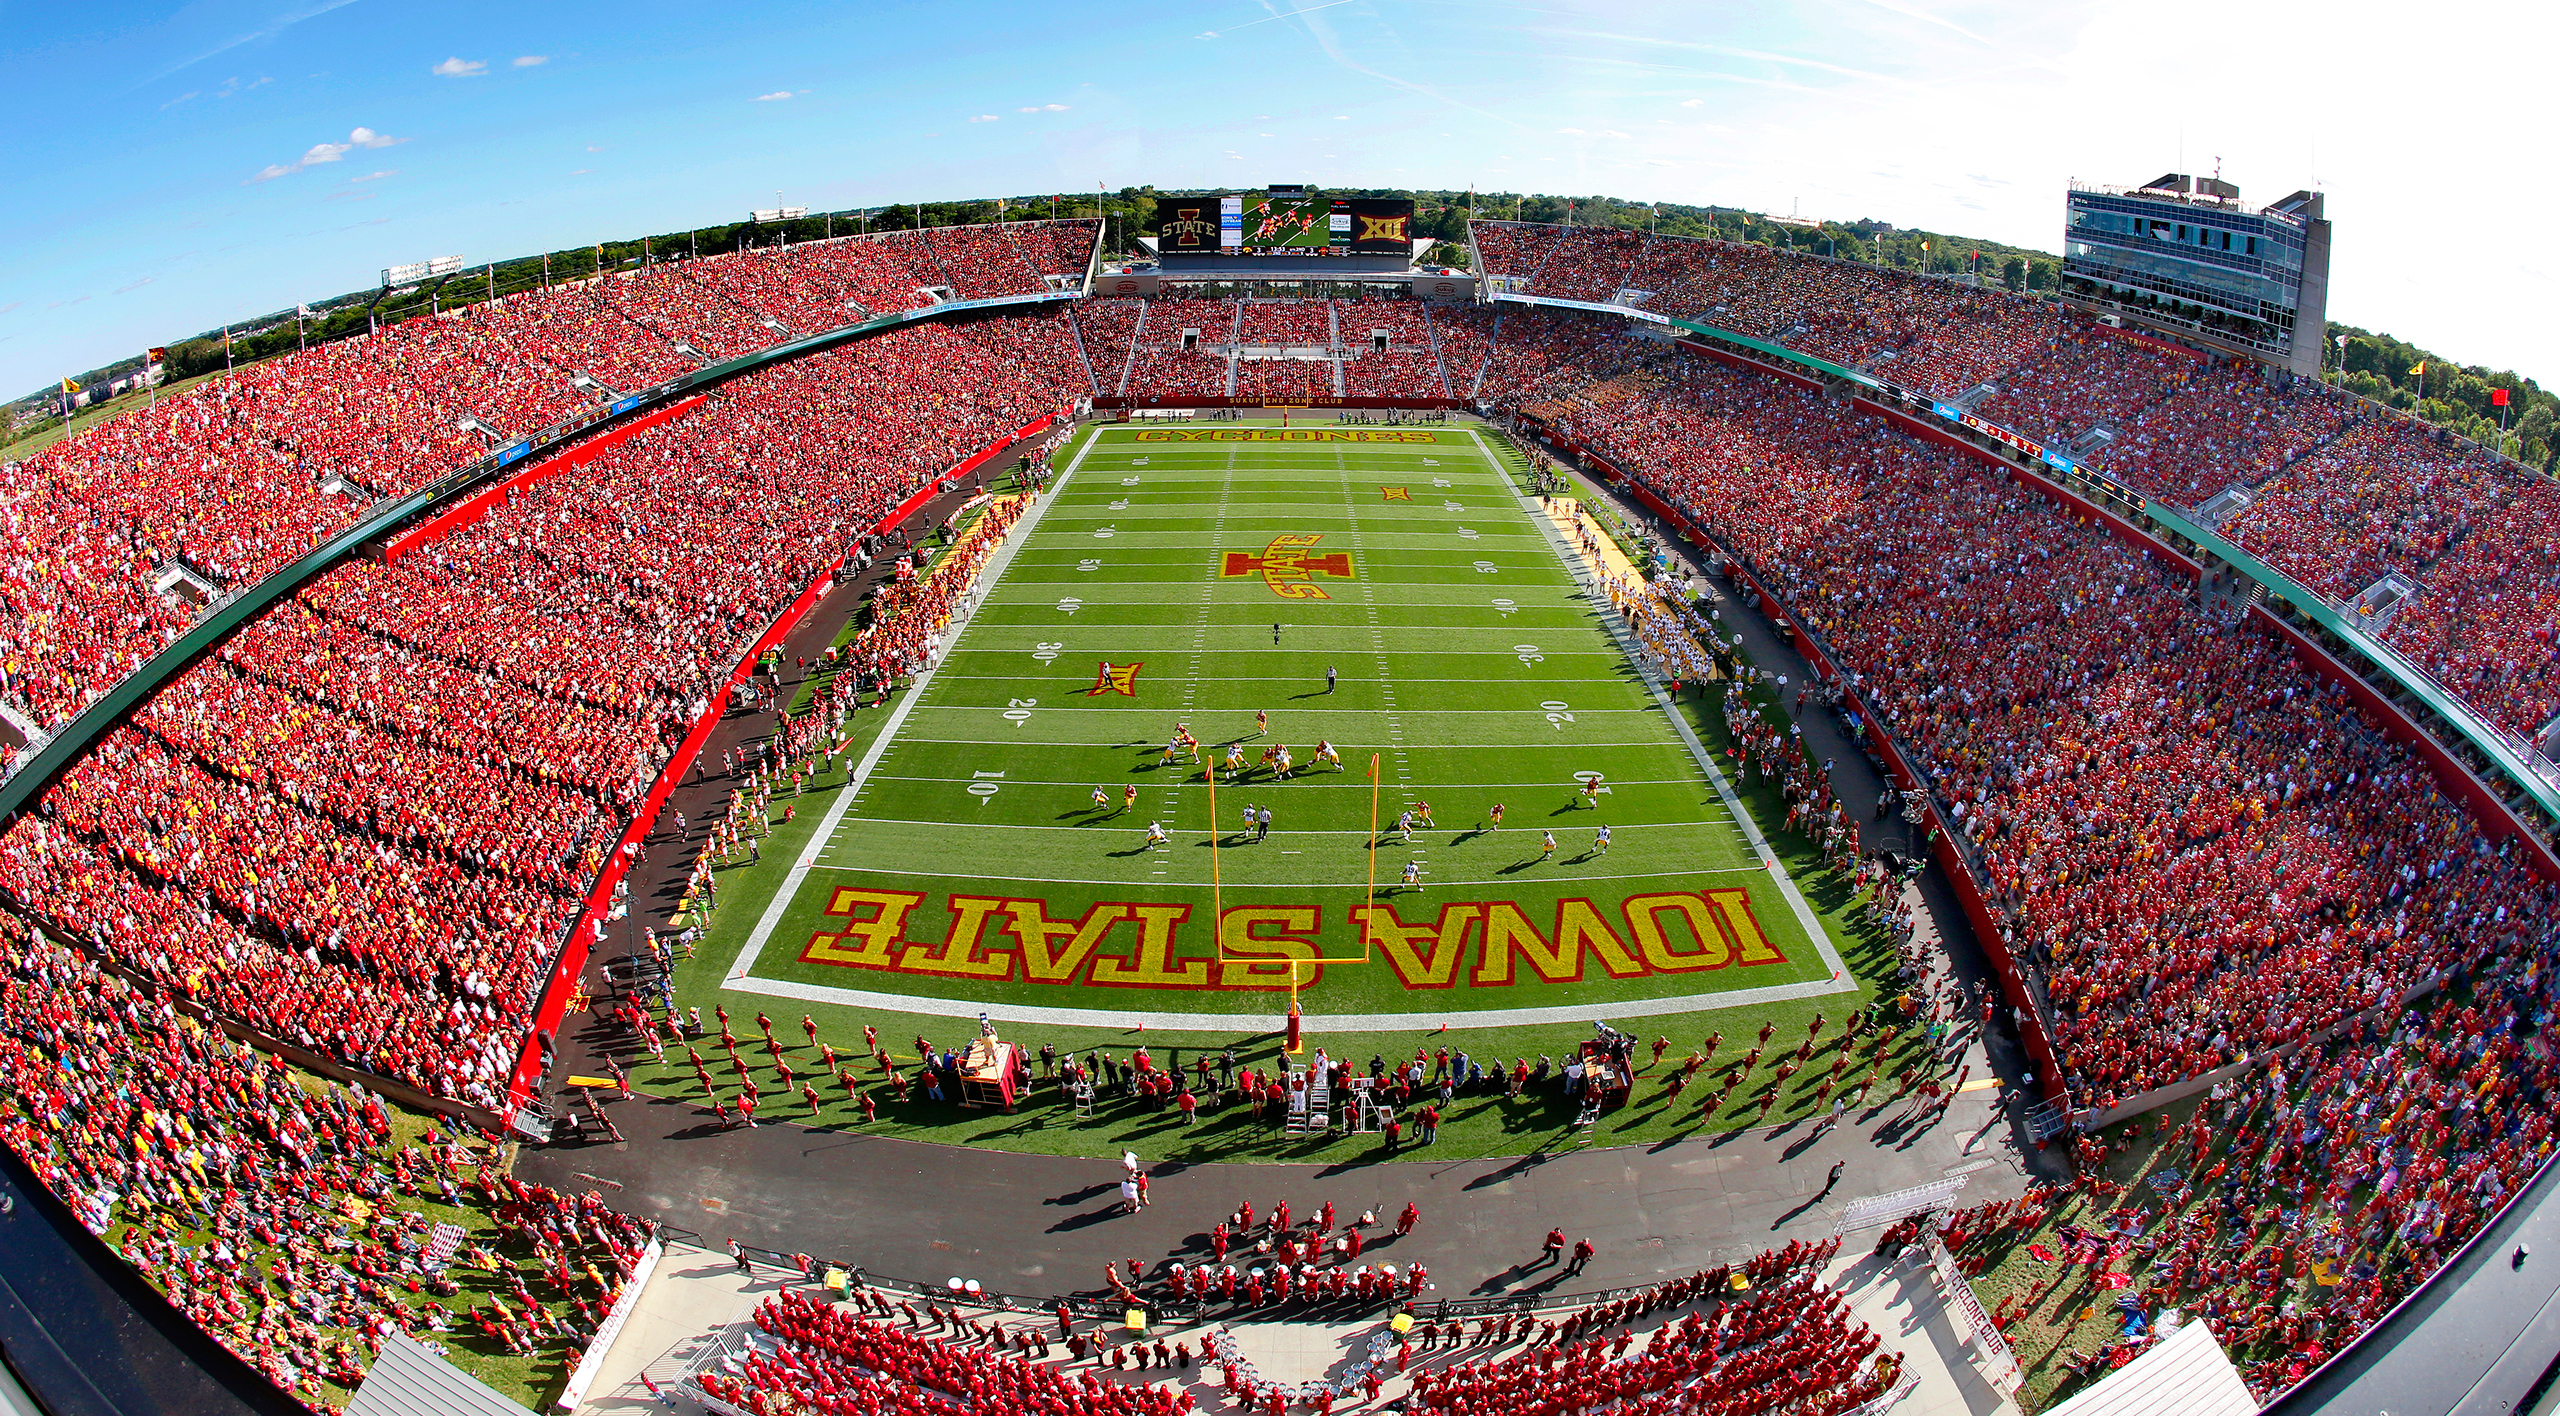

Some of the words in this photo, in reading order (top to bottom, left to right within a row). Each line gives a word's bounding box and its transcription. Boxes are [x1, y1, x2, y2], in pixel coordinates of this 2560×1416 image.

[1162, 220, 1216, 238] STATE
[1136, 429, 1437, 443] CYCLONES
[1093, 527, 1116, 539] 40
[1457, 528, 1480, 541] 40
[1076, 558, 1102, 572] 50
[1261, 534, 1332, 599] STATE
[1472, 560, 1499, 574] 50
[1056, 596, 1084, 612] 40
[1491, 598, 1519, 615] 40
[1032, 642, 1064, 660] 30
[1513, 644, 1545, 663] 30
[1002, 697, 1038, 721] 20
[1540, 700, 1577, 723] 20
[966, 769, 1006, 796] 10
[1573, 769, 1613, 796] 10
[797, 885, 1324, 993] STATE
[1348, 886, 1788, 991] IOWA
[591, 1302, 627, 1353] CYCLONE
[617, 1276, 641, 1305] CLUB
[1952, 1274, 1986, 1326] CYCLONE
[1978, 1322, 2004, 1356] CLUB
[1953, 1295, 1977, 1336] HILLSIDE
